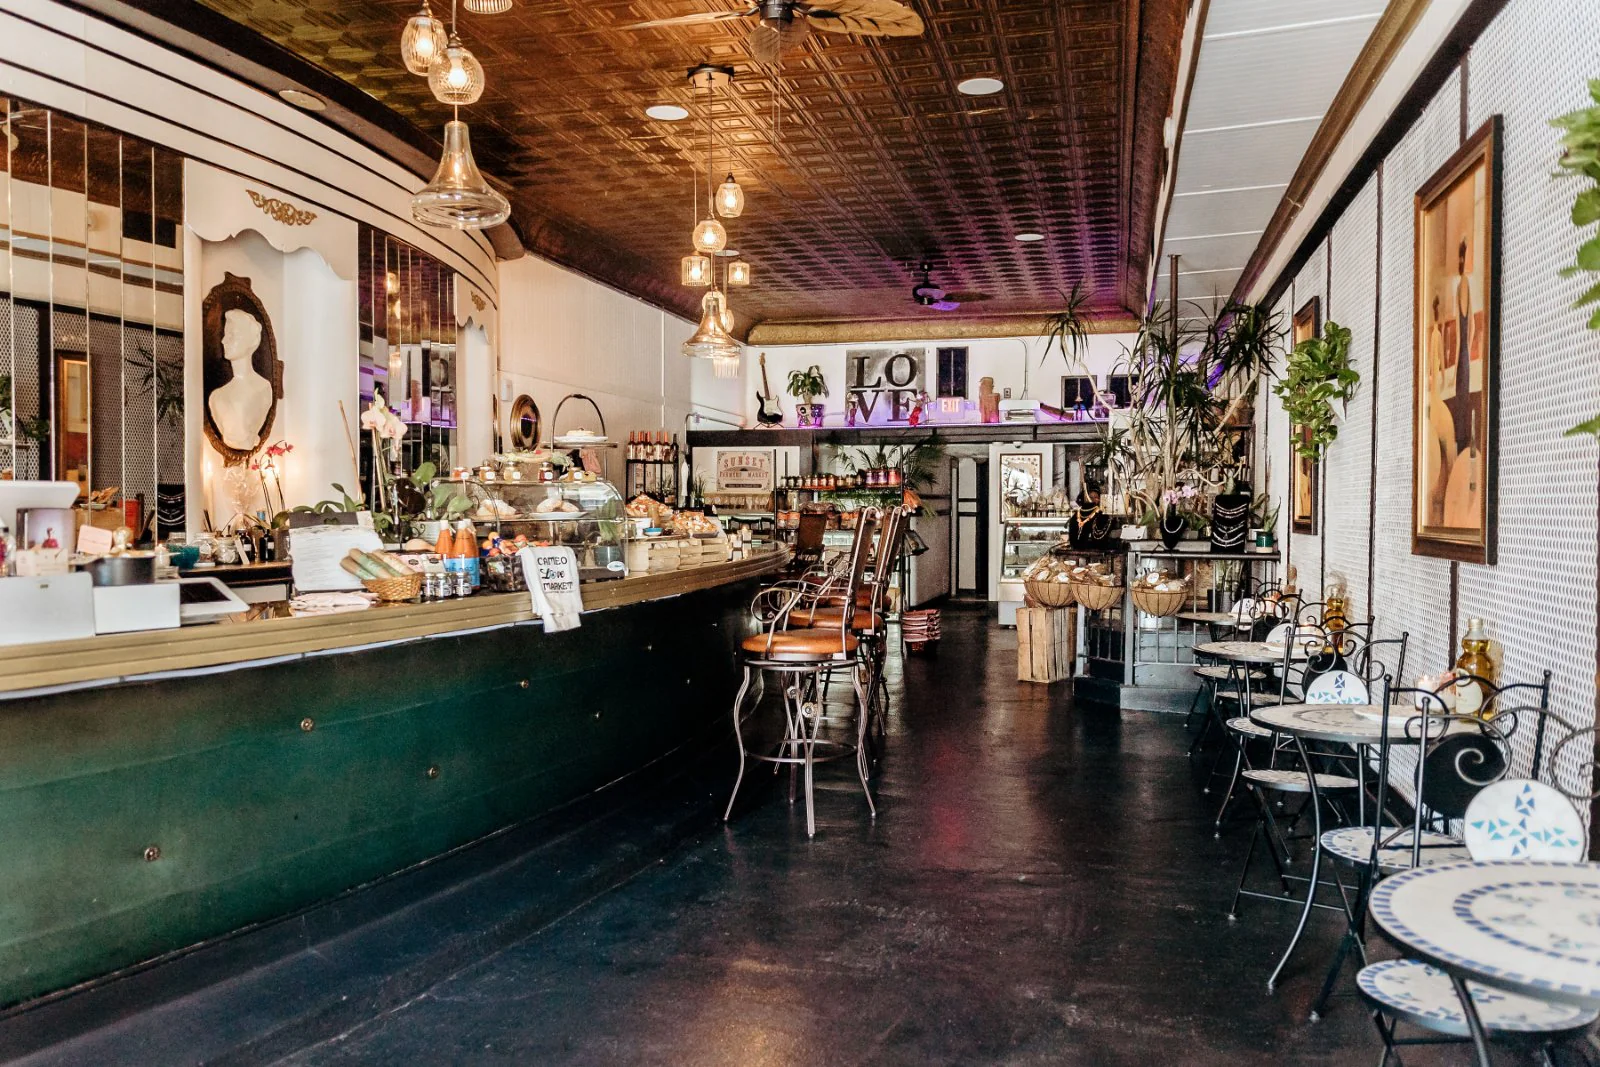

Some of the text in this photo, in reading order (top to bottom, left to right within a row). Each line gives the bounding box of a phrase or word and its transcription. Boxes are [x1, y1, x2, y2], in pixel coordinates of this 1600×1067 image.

[851, 354, 917, 388] LO
[942, 399, 960, 412] EXIT
[724, 456, 765, 468] SUNSET
[537, 557, 568, 566] CAMEO
[543, 582, 573, 591] MARKET
